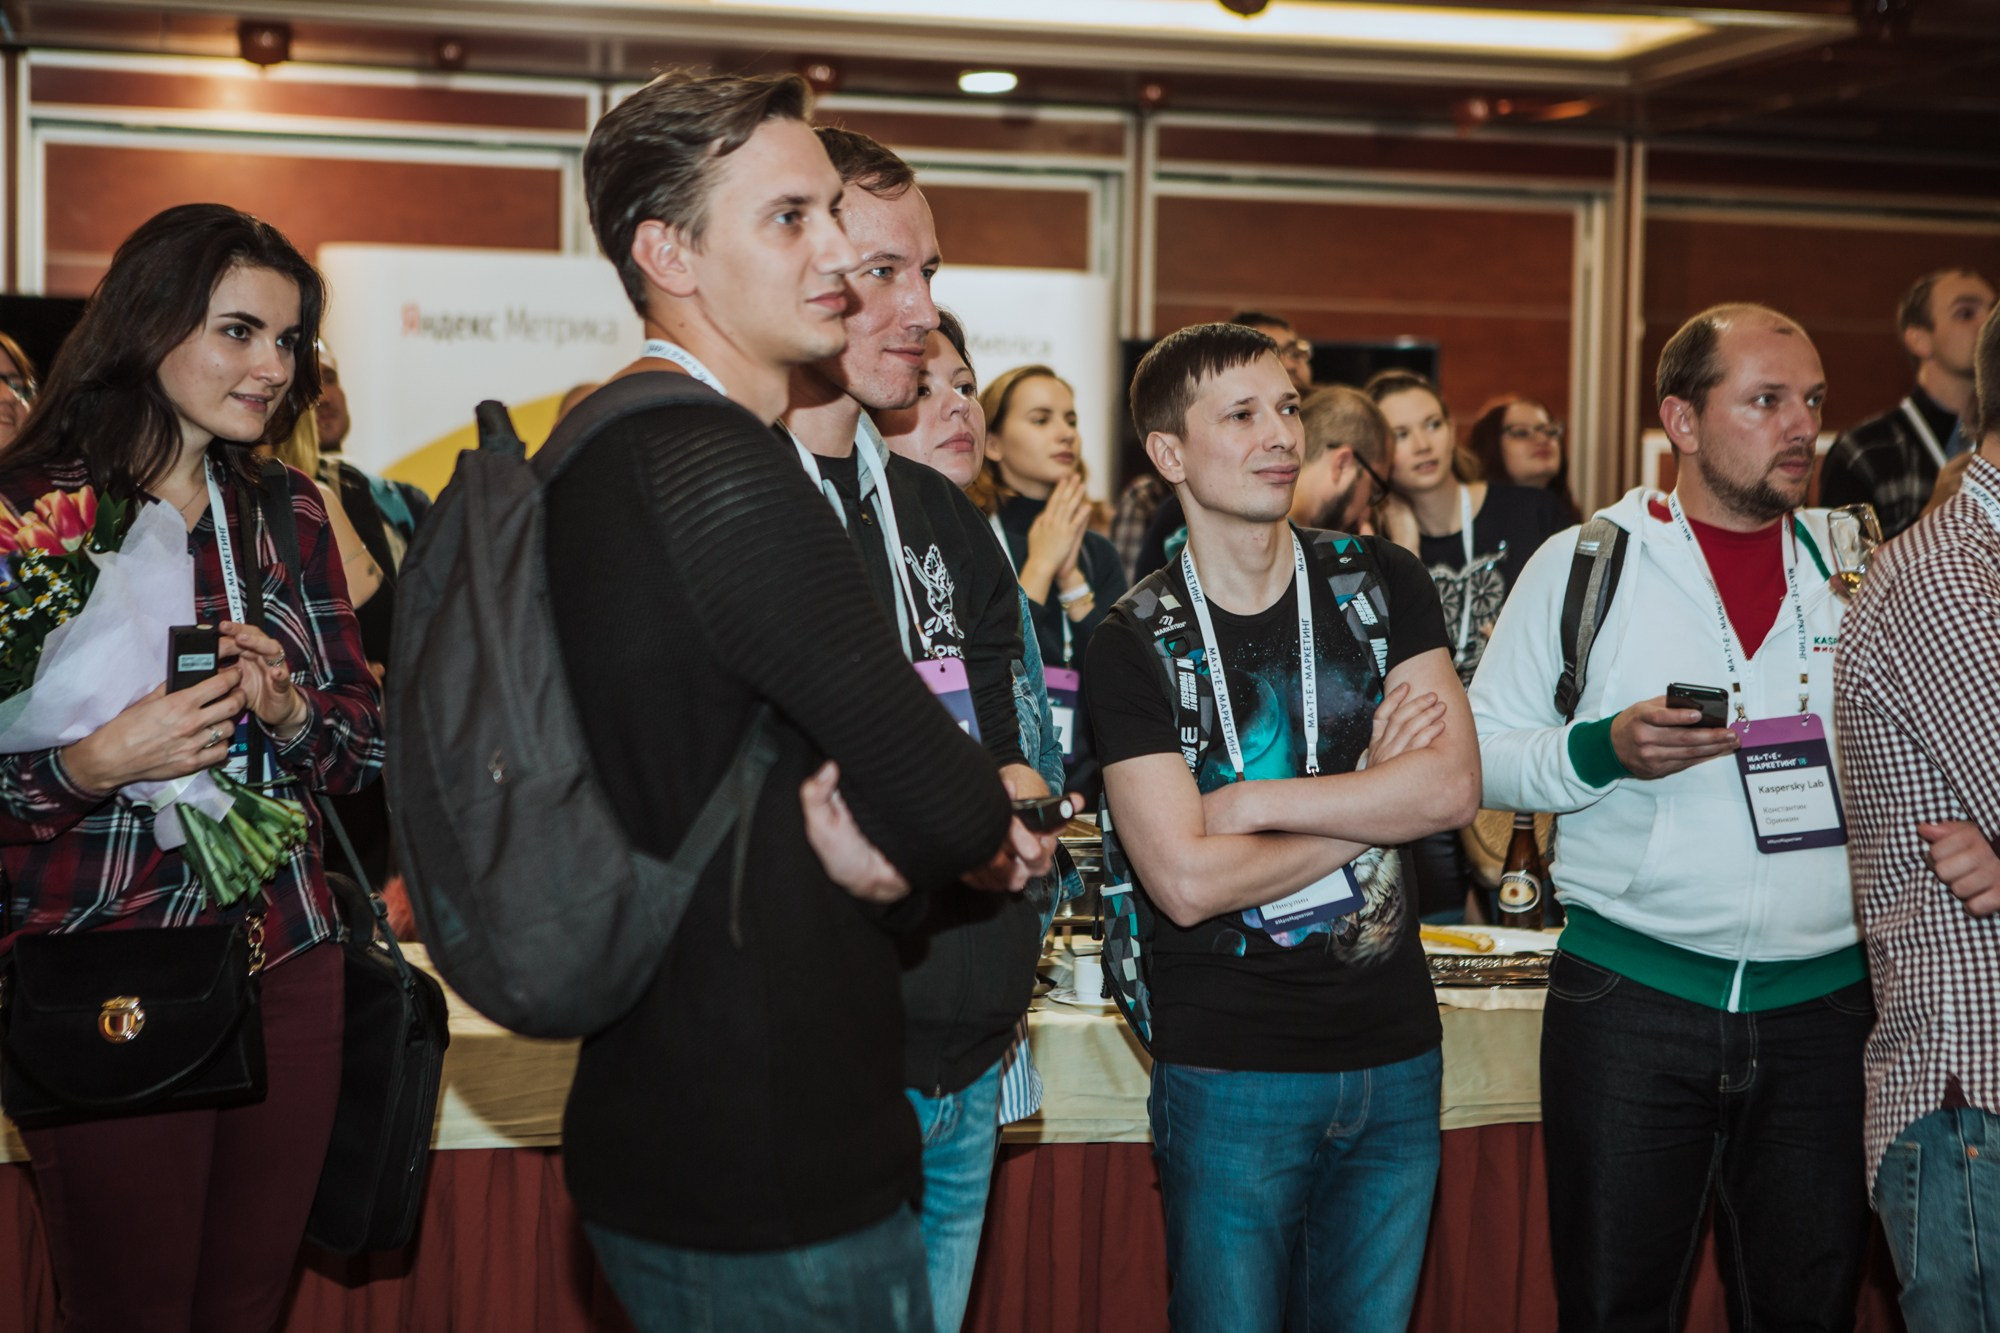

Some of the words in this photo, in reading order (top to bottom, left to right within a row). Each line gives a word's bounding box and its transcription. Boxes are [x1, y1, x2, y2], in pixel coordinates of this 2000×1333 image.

[400, 299, 497, 344] Яндекс
[504, 303, 619, 351] Метрика
[218, 525, 237, 587] МАРКЕТИНГ
[1183, 551, 1204, 604] МАРКЕТИНГ
[1302, 618, 1314, 681] МАРКЕТИНГ
[1795, 605, 1807, 661] МАРКЕТИНГ
[1179, 671, 1190, 710] YOURSELF
[1217, 694, 1240, 756] МАРКЕТИНГ
[1749, 758, 1797, 771] МАРКЕТИНГ
[1758, 783, 1806, 795] Kaspersky
[1807, 779, 1825, 789] Lab
[1763, 804, 1807, 814] Константин
[1272, 897, 1309, 911] Никулин
